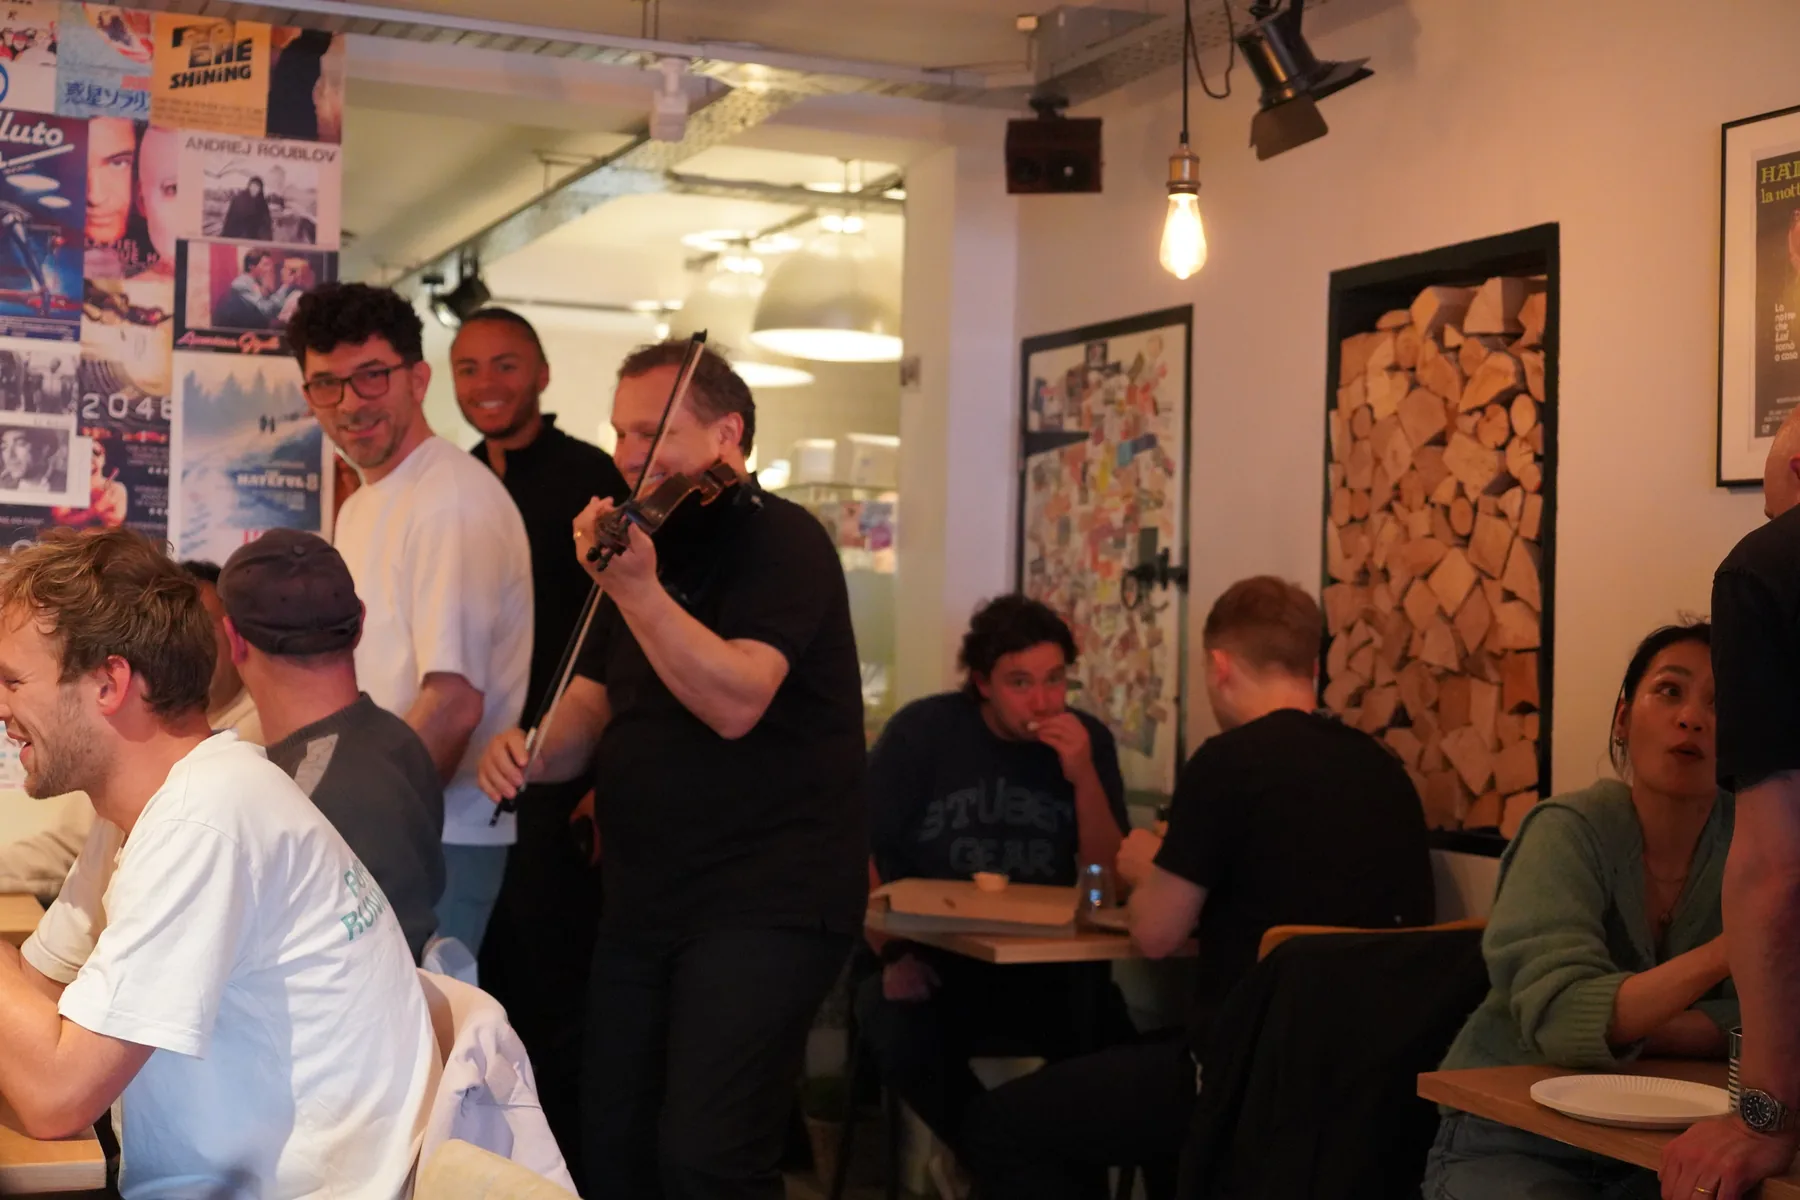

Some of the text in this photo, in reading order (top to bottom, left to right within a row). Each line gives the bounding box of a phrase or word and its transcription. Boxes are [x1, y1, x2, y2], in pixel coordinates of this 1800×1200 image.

[185, 136, 252, 154] ANDREJ
[82, 392, 171, 421] 2046
[950, 836, 1057, 878] GEAR
